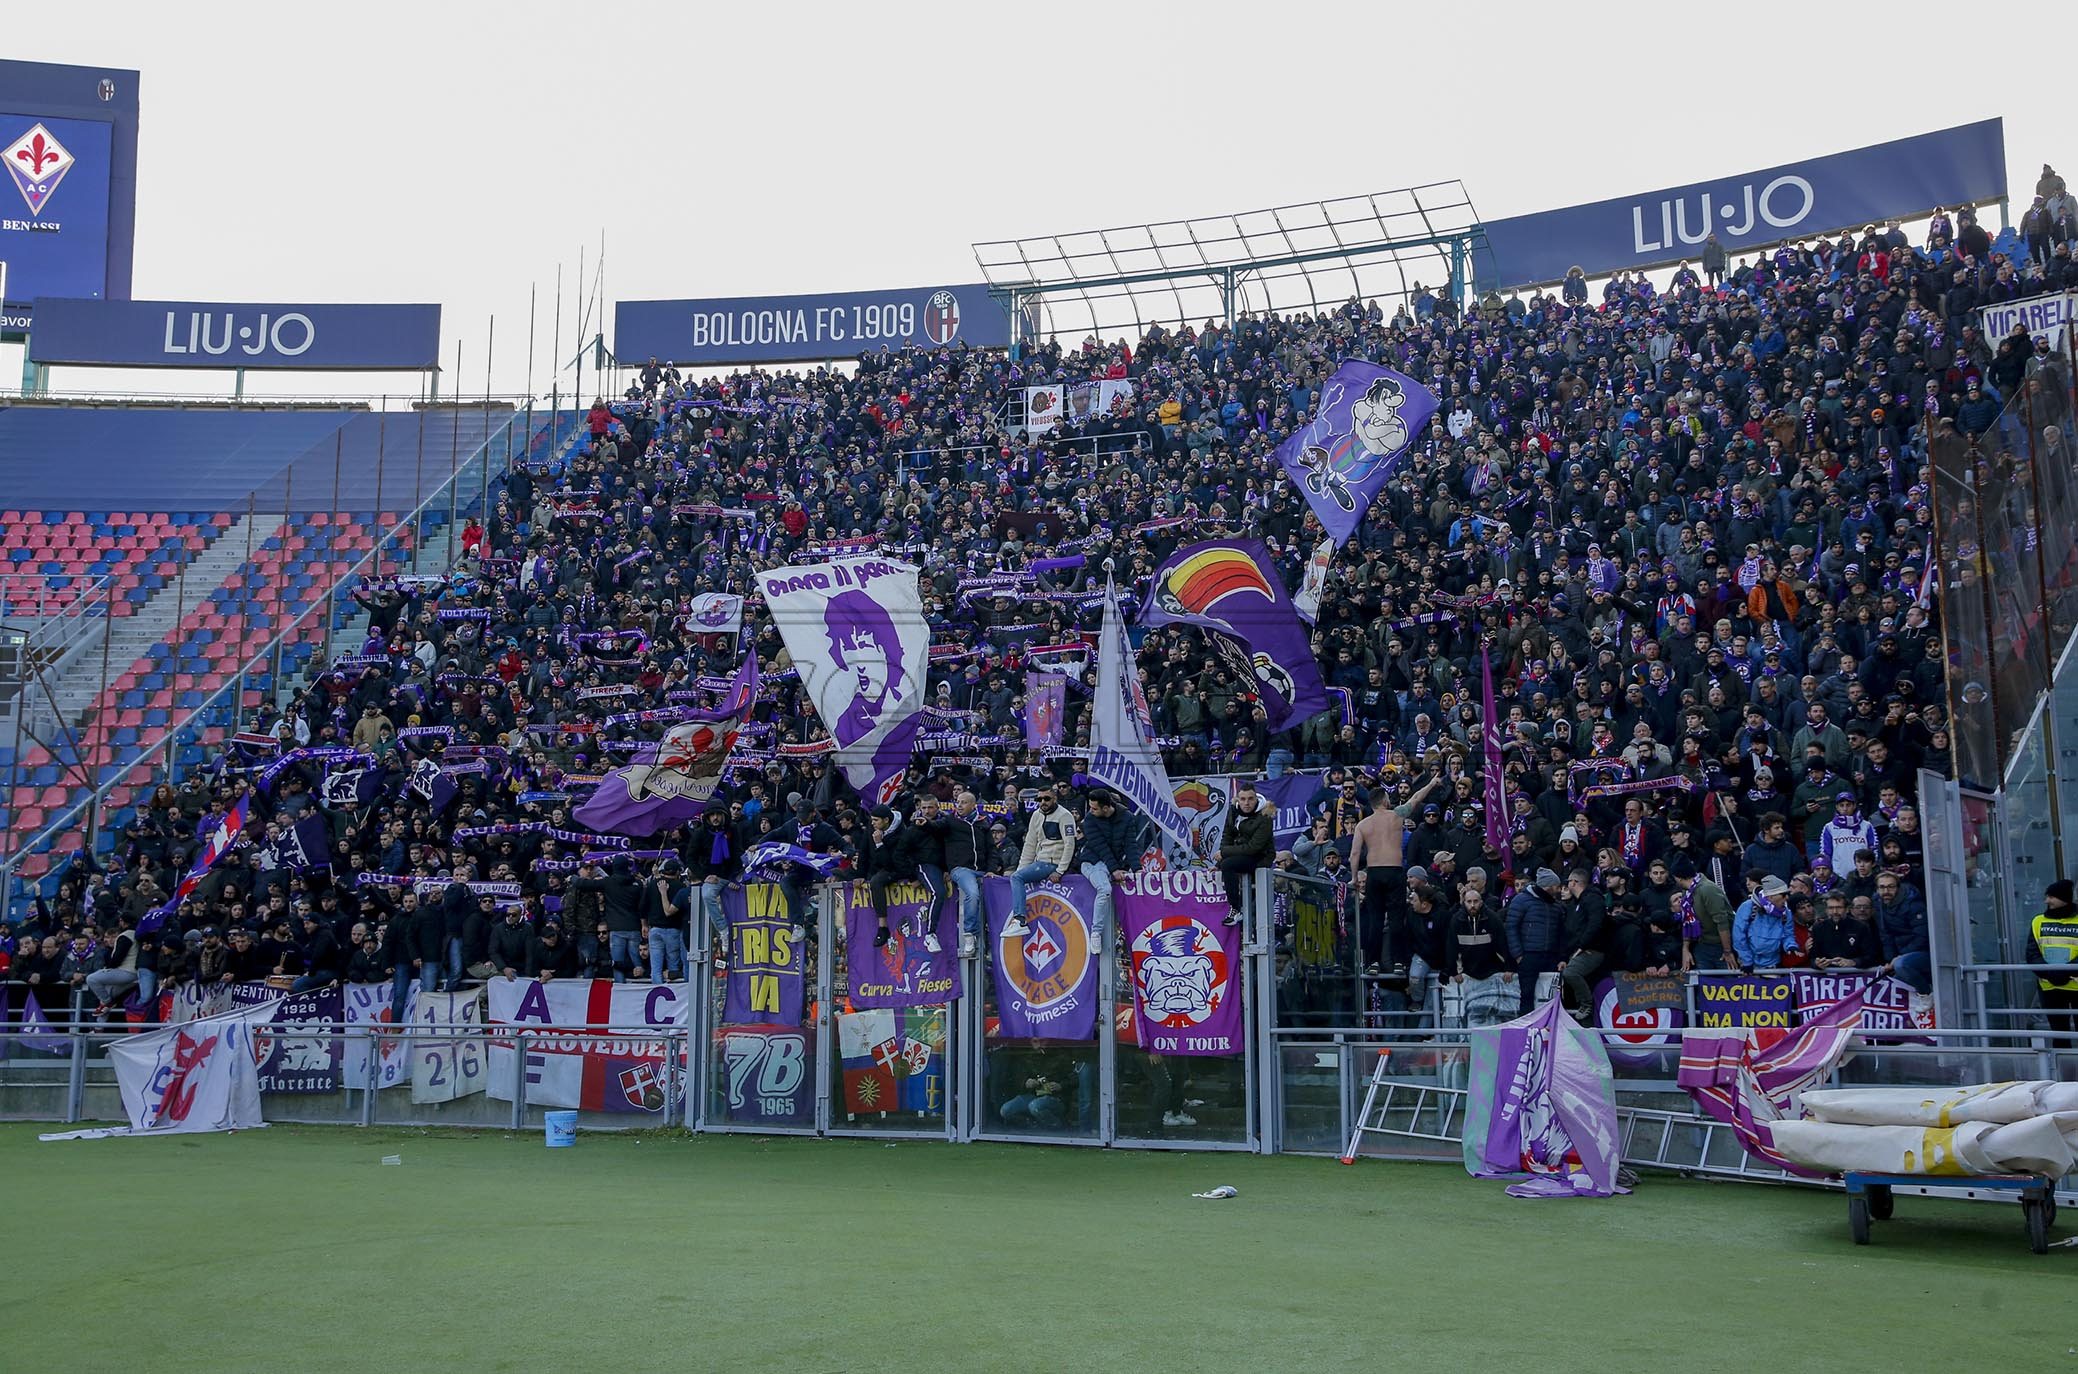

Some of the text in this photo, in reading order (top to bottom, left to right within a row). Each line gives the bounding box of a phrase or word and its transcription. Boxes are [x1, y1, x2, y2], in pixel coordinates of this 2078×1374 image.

[2, 219, 61, 233] BENASSI
[693, 303, 915, 347] BOLOGNA FC 1909
[1834, 836, 1866, 844] TOYOTA
[1040, 879, 1074, 899] scesi
[1026, 899, 1072, 926] RIPPO
[859, 982, 893, 997] Curva
[917, 978, 953, 994] Fiesoe
[1702, 984, 1790, 1001] VACILLO
[282, 1003, 317, 1015] 1926
[514, 980, 676, 1031] A C
[1703, 1010, 1789, 1028] MA NON
[1154, 1036, 1231, 1051] ON TOUR
[759, 1098, 795, 1116] 1965
